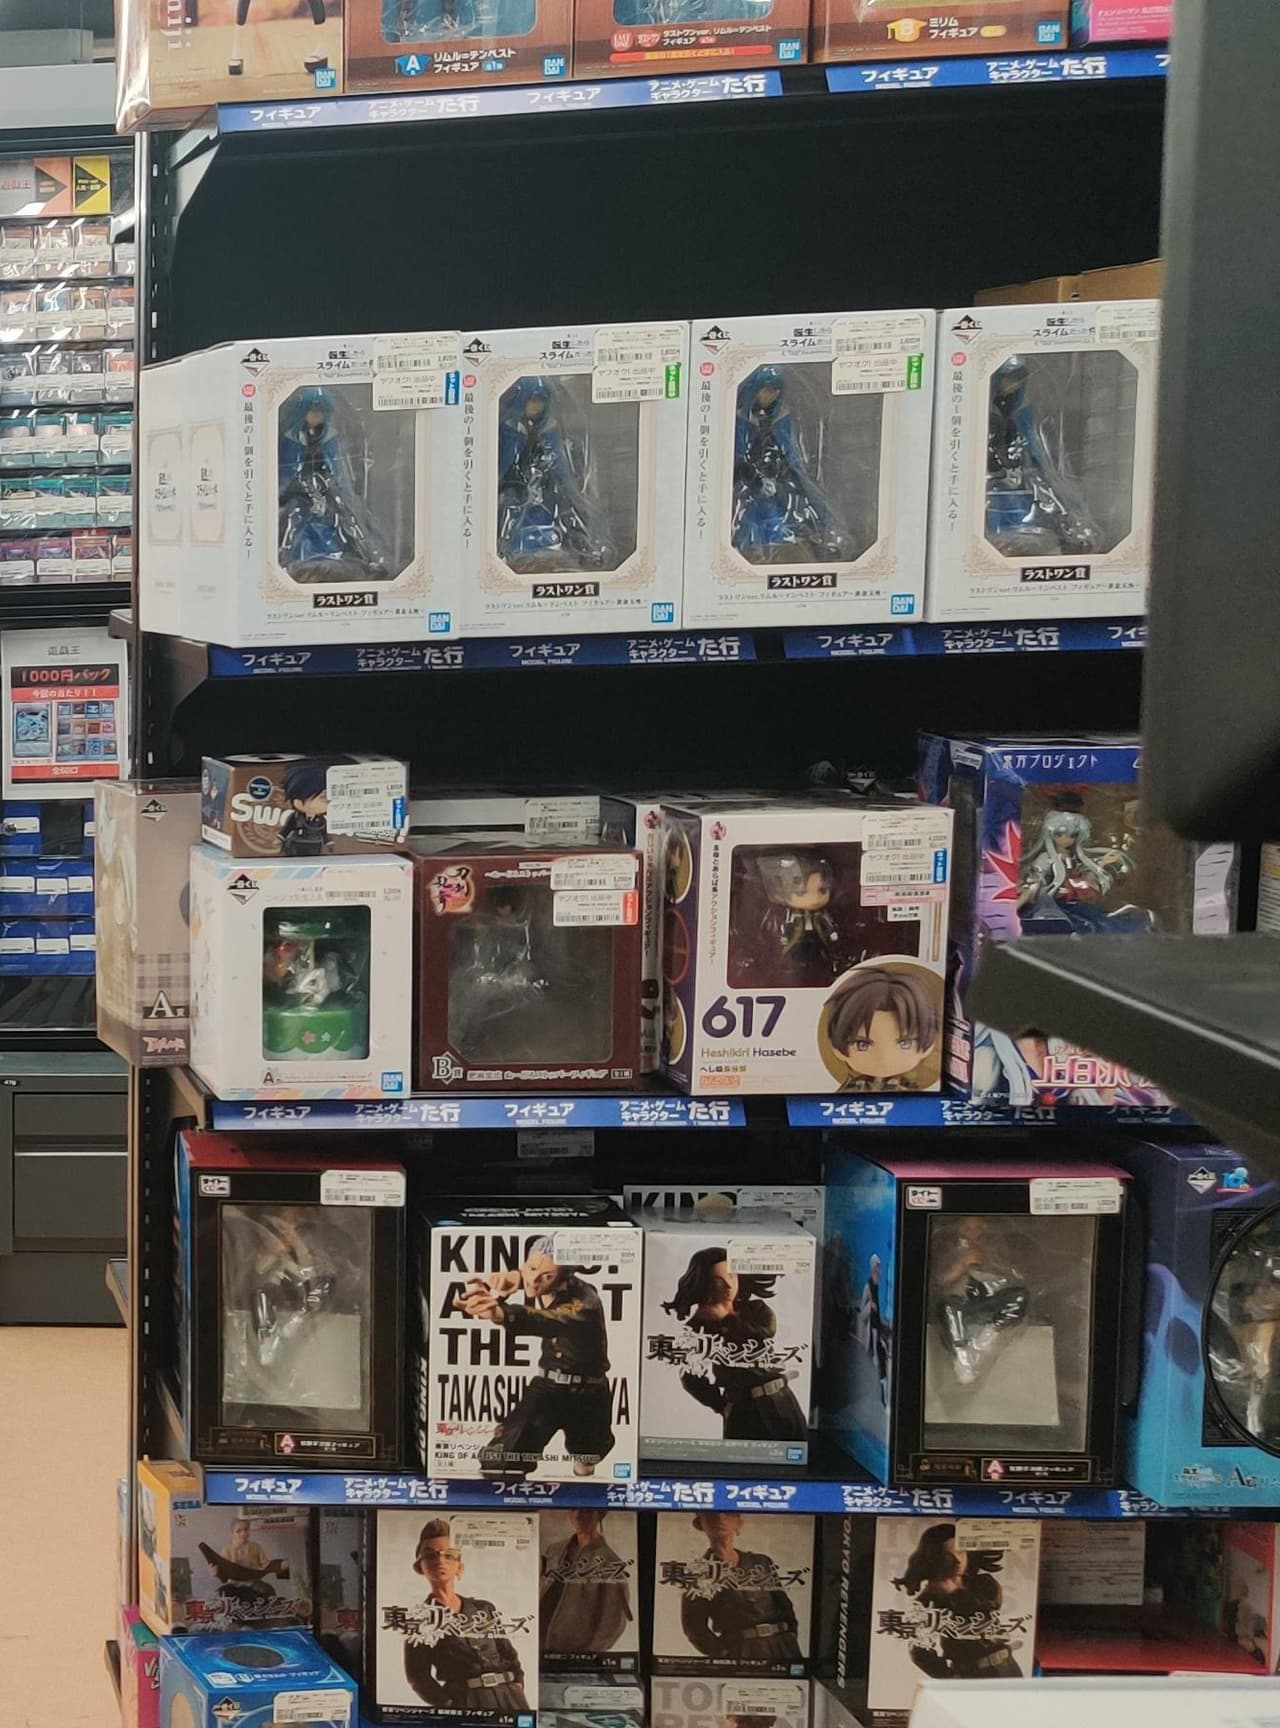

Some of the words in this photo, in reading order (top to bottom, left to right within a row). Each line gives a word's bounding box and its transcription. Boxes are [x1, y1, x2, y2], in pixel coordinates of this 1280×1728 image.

[928, 17, 959, 27] ミリム
[928, 27, 978, 39] フィギュア
[663, 37, 696, 47] フィギュア
[433, 62, 479, 74] フィギュア
[1060, 56, 1107, 75] た行
[528, 87, 601, 103] フィギュア
[438, 96, 480, 114] た行
[1024, 567, 1087, 579] ラストワン賞
[771, 576, 834, 588] ラストワン賞
[535, 584, 595, 597] ラストワン賞
[316, 593, 375, 605] ラストワン賞
[508, 643, 581, 659] フィギュア
[697, 636, 741, 656] た行
[244, 651, 312, 667] フィギュア
[21, 667, 112, 683] 1000円パック
[702, 995, 787, 1039] 617
[701, 1047, 750, 1058] Heshikiri
[753, 1047, 797, 1057] Hasebe
[243, 1105, 313, 1119] フィギュア
[421, 1103, 461, 1122] た行
[820, 1101, 894, 1115] フィギュア
[440, 1235, 550, 1273] KIN
[439, 1327, 531, 1367] THE
[435, 1451, 456, 1460] KING
[235, 1478, 303, 1493] フィギュア
[409, 1479, 448, 1498] た行
[725, 1485, 797, 1500] フィギュア
[911, 1487, 953, 1508] た行
